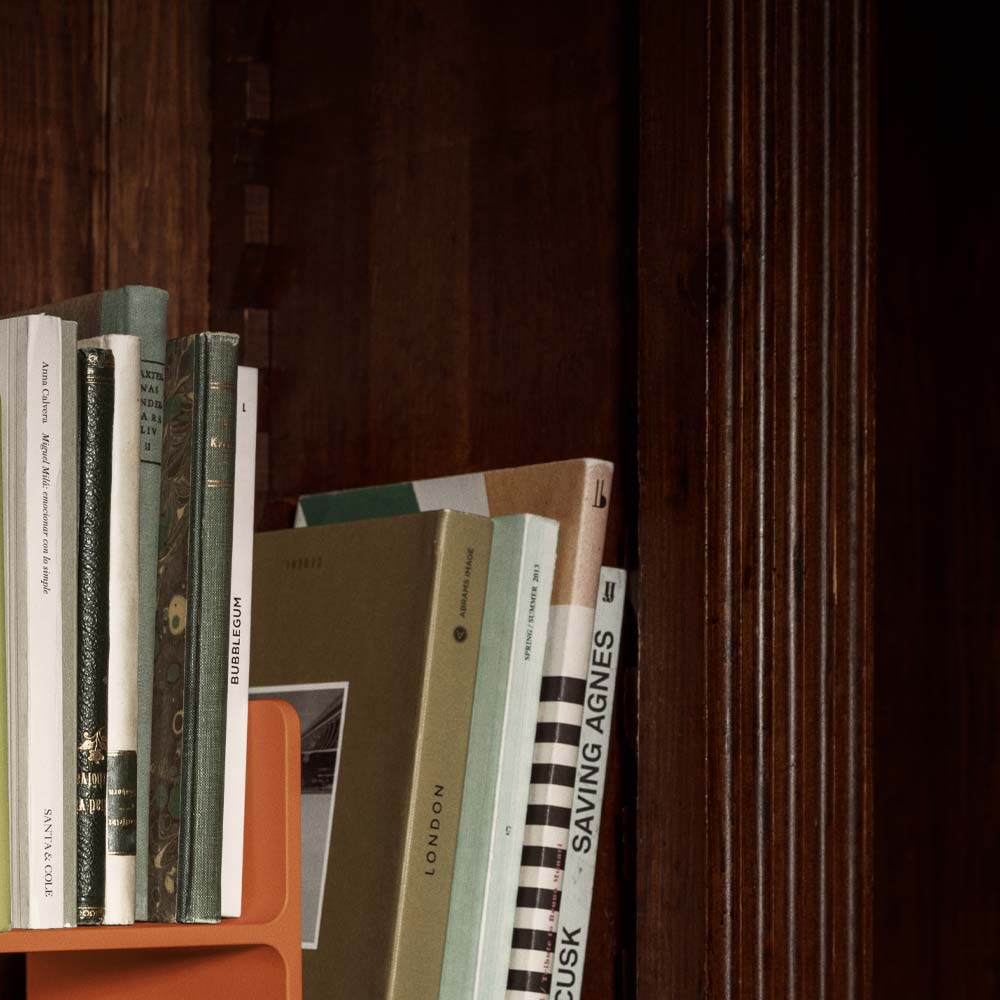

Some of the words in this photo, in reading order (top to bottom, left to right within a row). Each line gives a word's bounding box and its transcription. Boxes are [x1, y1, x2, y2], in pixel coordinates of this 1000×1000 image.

[41, 361, 50, 386] Anna
[42, 388, 51, 424] Calvera
[40, 432, 51, 464] Miguel
[42, 491, 51, 536] emocionar
[42, 555, 52, 564] lo
[43, 538, 51, 553] con
[41, 565, 51, 595] simple
[528, 586, 538, 624] SUMMER
[230, 597, 242, 685] BUBBLEGUM
[524, 629, 534, 661] SPRING
[586, 630, 614, 734] AGNES
[572, 743, 602, 854] SAVING
[43, 808, 53, 851] SANTA
[425, 784, 445, 876] LONDON
[44, 852, 53, 862] &
[44, 864, 53, 898] COLE
